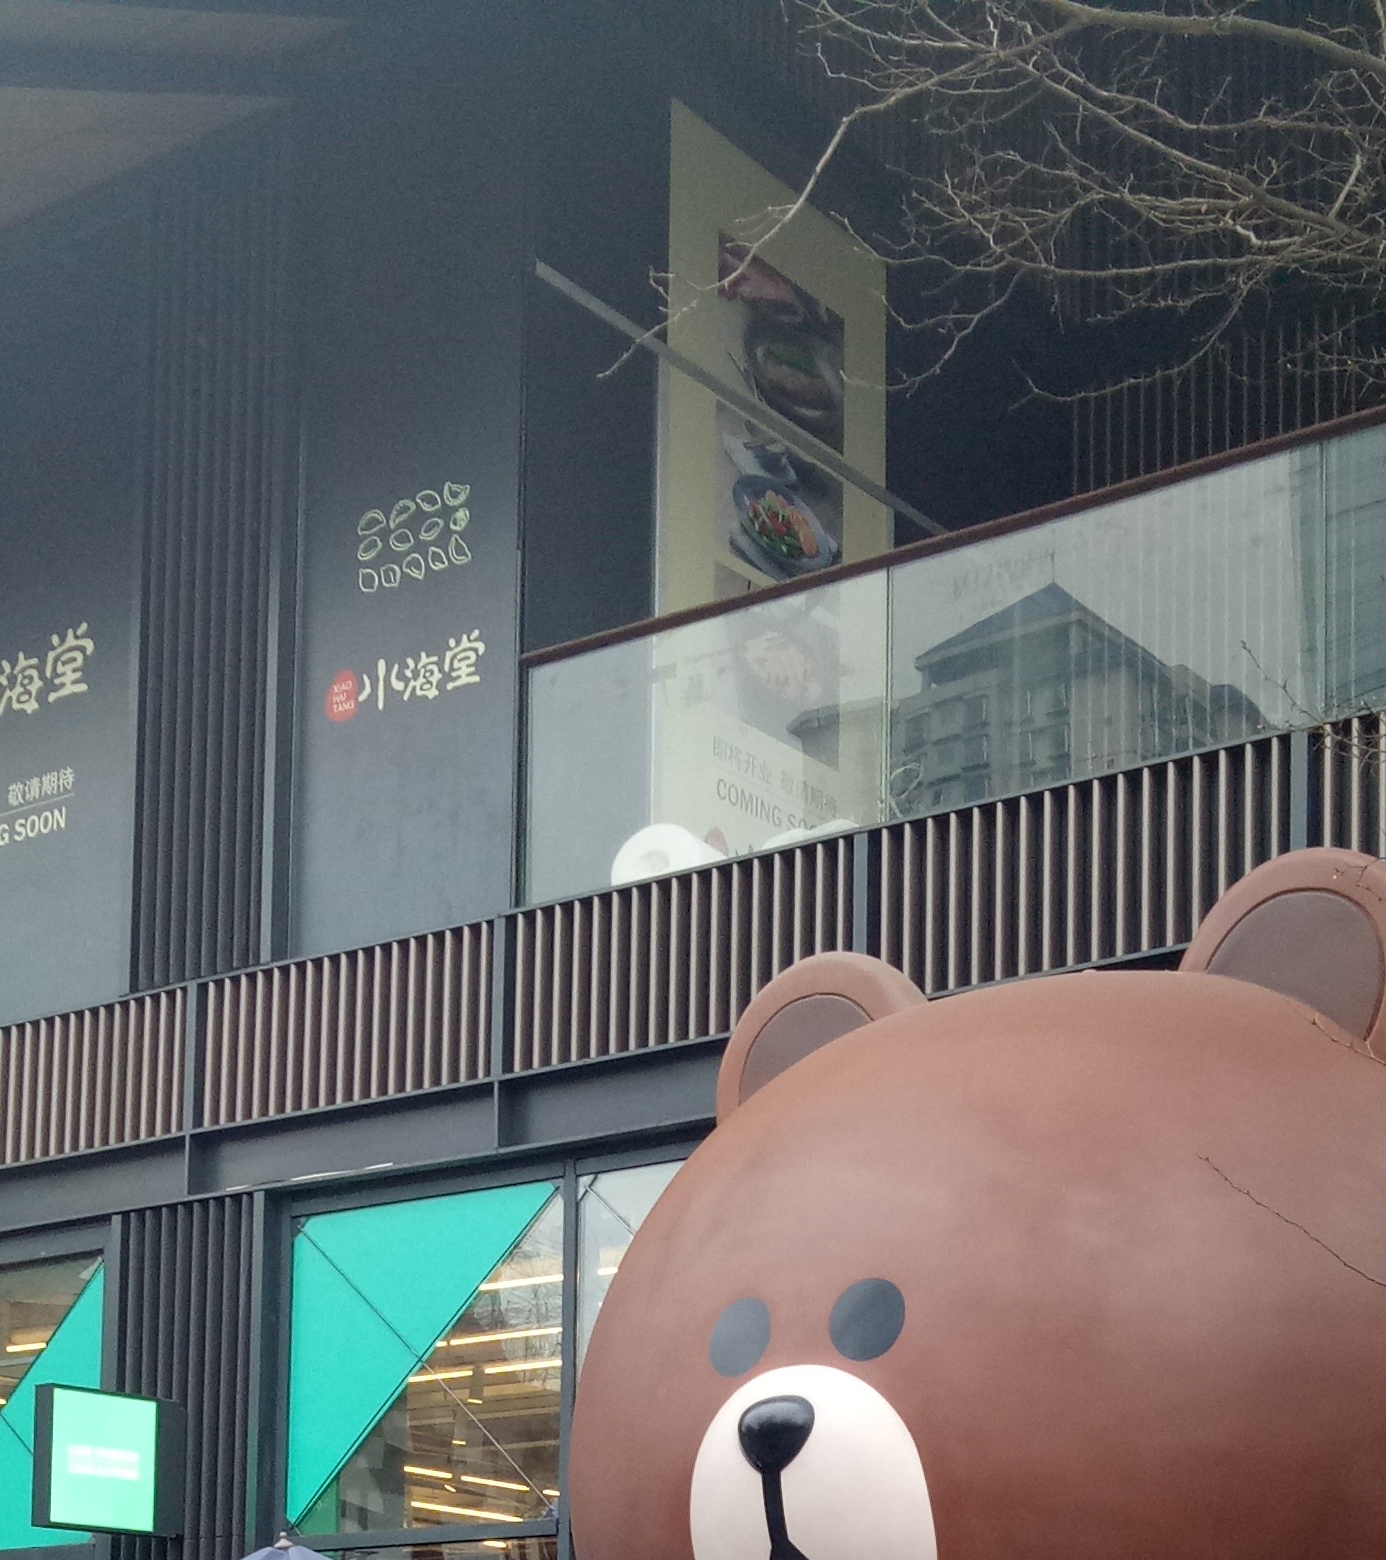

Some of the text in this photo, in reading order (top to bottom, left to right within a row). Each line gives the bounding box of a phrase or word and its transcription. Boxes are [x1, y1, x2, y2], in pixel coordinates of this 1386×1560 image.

[358, 629, 486, 711] 小海堂
[7, 766, 75, 806] 敬请期待
[716, 778, 782, 828] COMING
[14, 806, 66, 841] SOON
